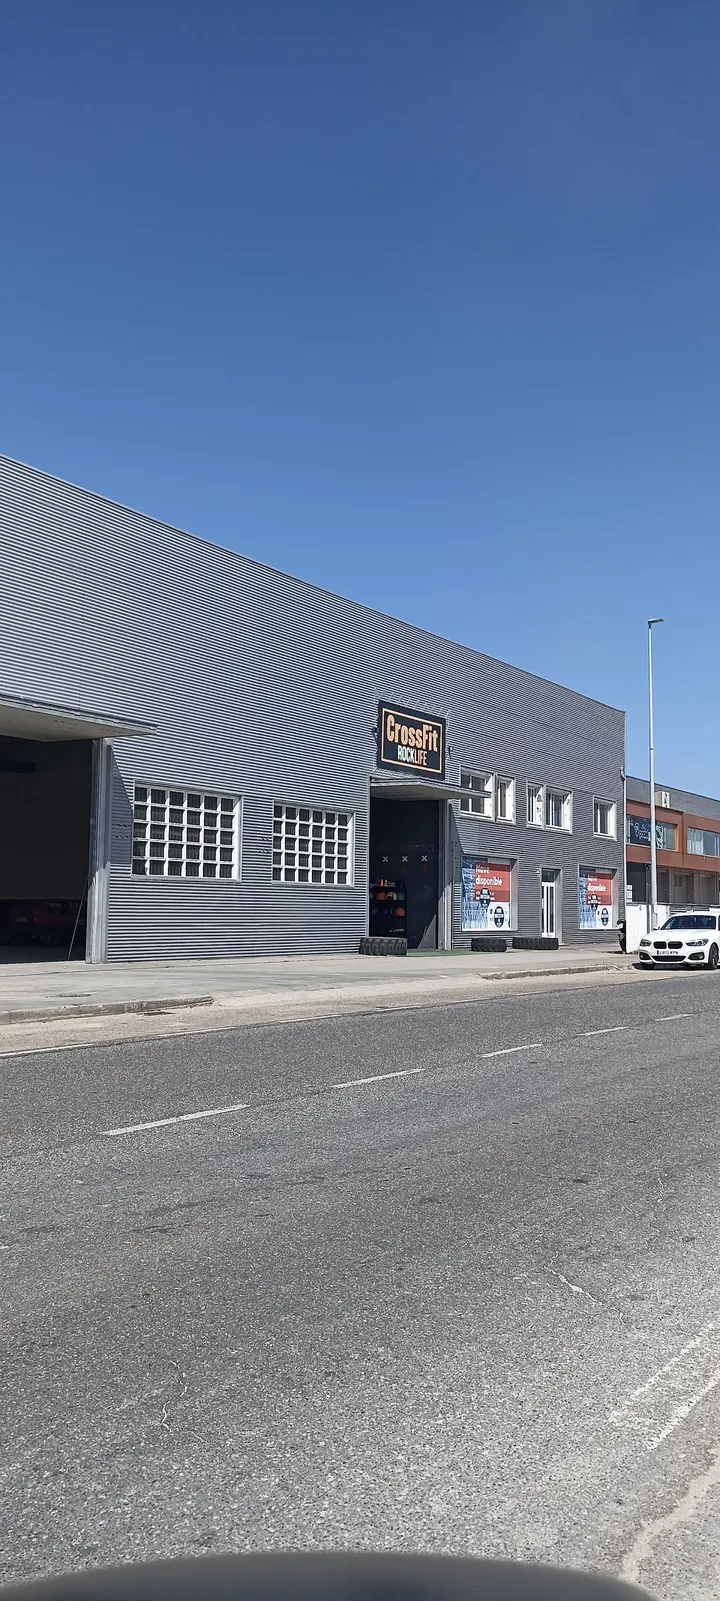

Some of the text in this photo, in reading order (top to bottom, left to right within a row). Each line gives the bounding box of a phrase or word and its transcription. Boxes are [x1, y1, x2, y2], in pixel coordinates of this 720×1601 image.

[386, 714, 438, 752] CrossFit
[397, 745, 427, 766] ROCKLIFE
[475, 875, 503, 888] disponible
